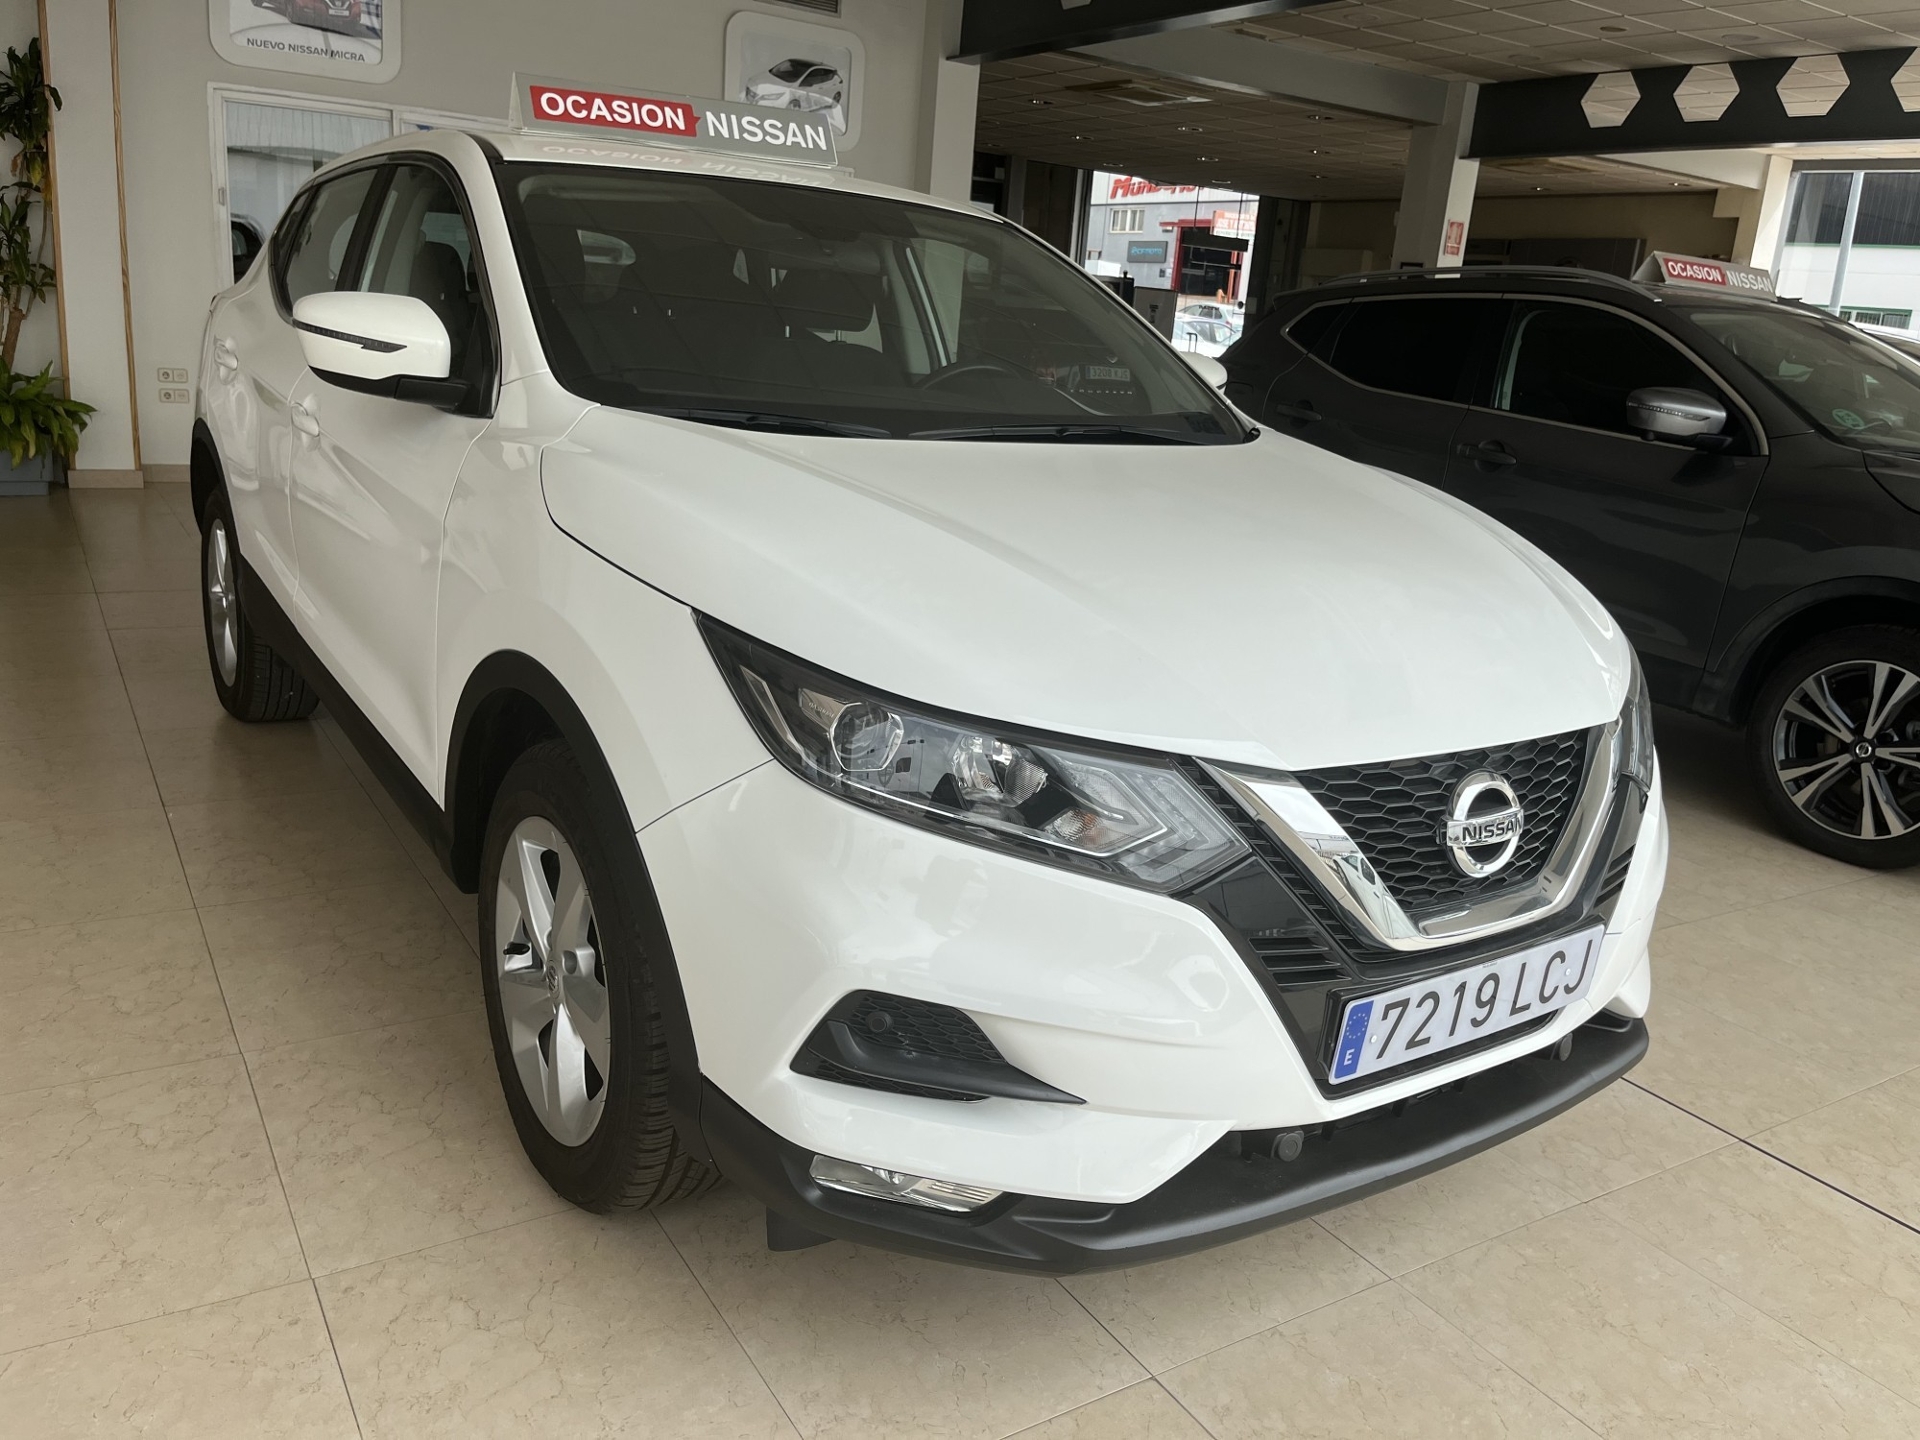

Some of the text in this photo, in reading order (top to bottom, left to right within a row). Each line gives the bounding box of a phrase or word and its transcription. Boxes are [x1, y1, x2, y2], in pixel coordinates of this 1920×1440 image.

[246, 37, 366, 63] NUEVO NISSAN MICRA
[540, 92, 828, 151] OCASION NISSAN
[1667, 261, 1774, 293] OCASION NISSAN
[1462, 816, 1522, 842] NISSAN
[1343, 938, 1594, 1066] E 7219 LCJ
